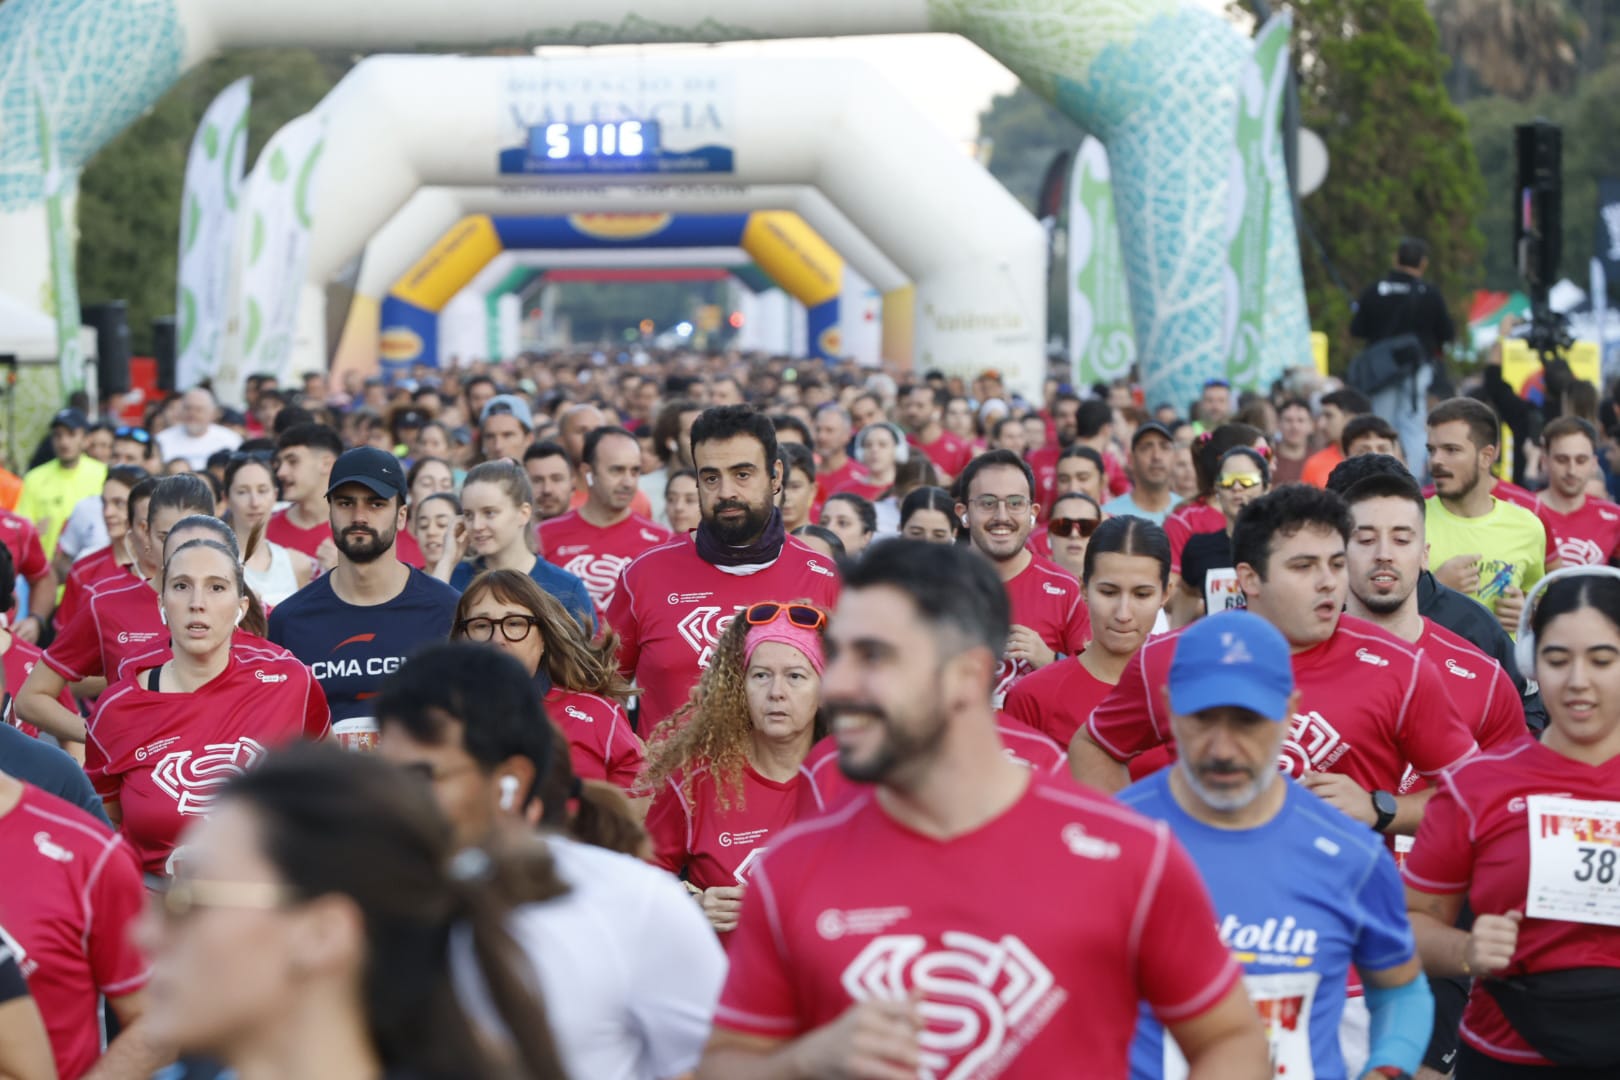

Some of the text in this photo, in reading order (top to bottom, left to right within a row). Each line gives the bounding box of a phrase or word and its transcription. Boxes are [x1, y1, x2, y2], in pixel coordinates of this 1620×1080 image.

[311, 656, 408, 680] CMA CG
[1573, 847, 1620, 885] 38
[1217, 913, 1318, 955] tolin
